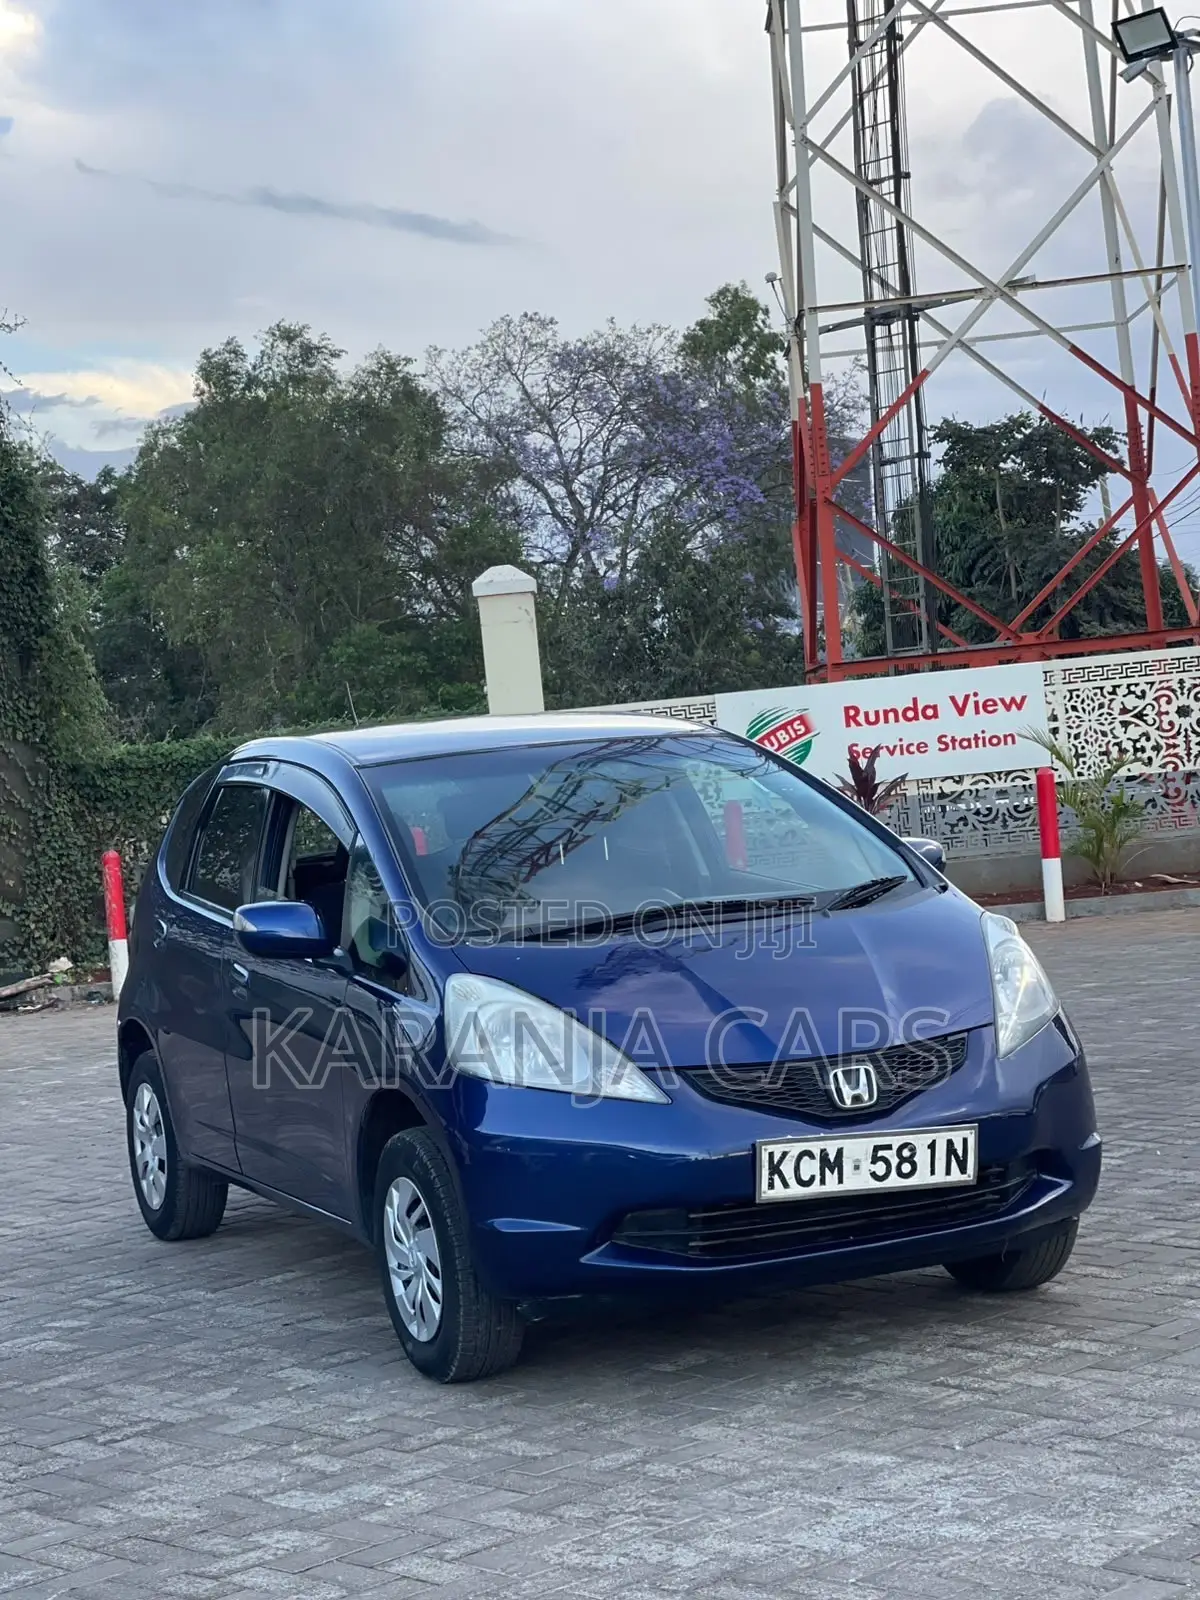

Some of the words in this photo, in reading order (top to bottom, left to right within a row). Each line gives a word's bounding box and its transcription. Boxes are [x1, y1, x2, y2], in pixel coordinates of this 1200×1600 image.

[843, 697, 940, 728] Runda
[949, 691, 1028, 718] View
[763, 720, 806, 751] UBIS
[937, 729, 1017, 753] Station
[767, 1147, 845, 1191] KCM
[869, 1136, 969, 1183] 581N
